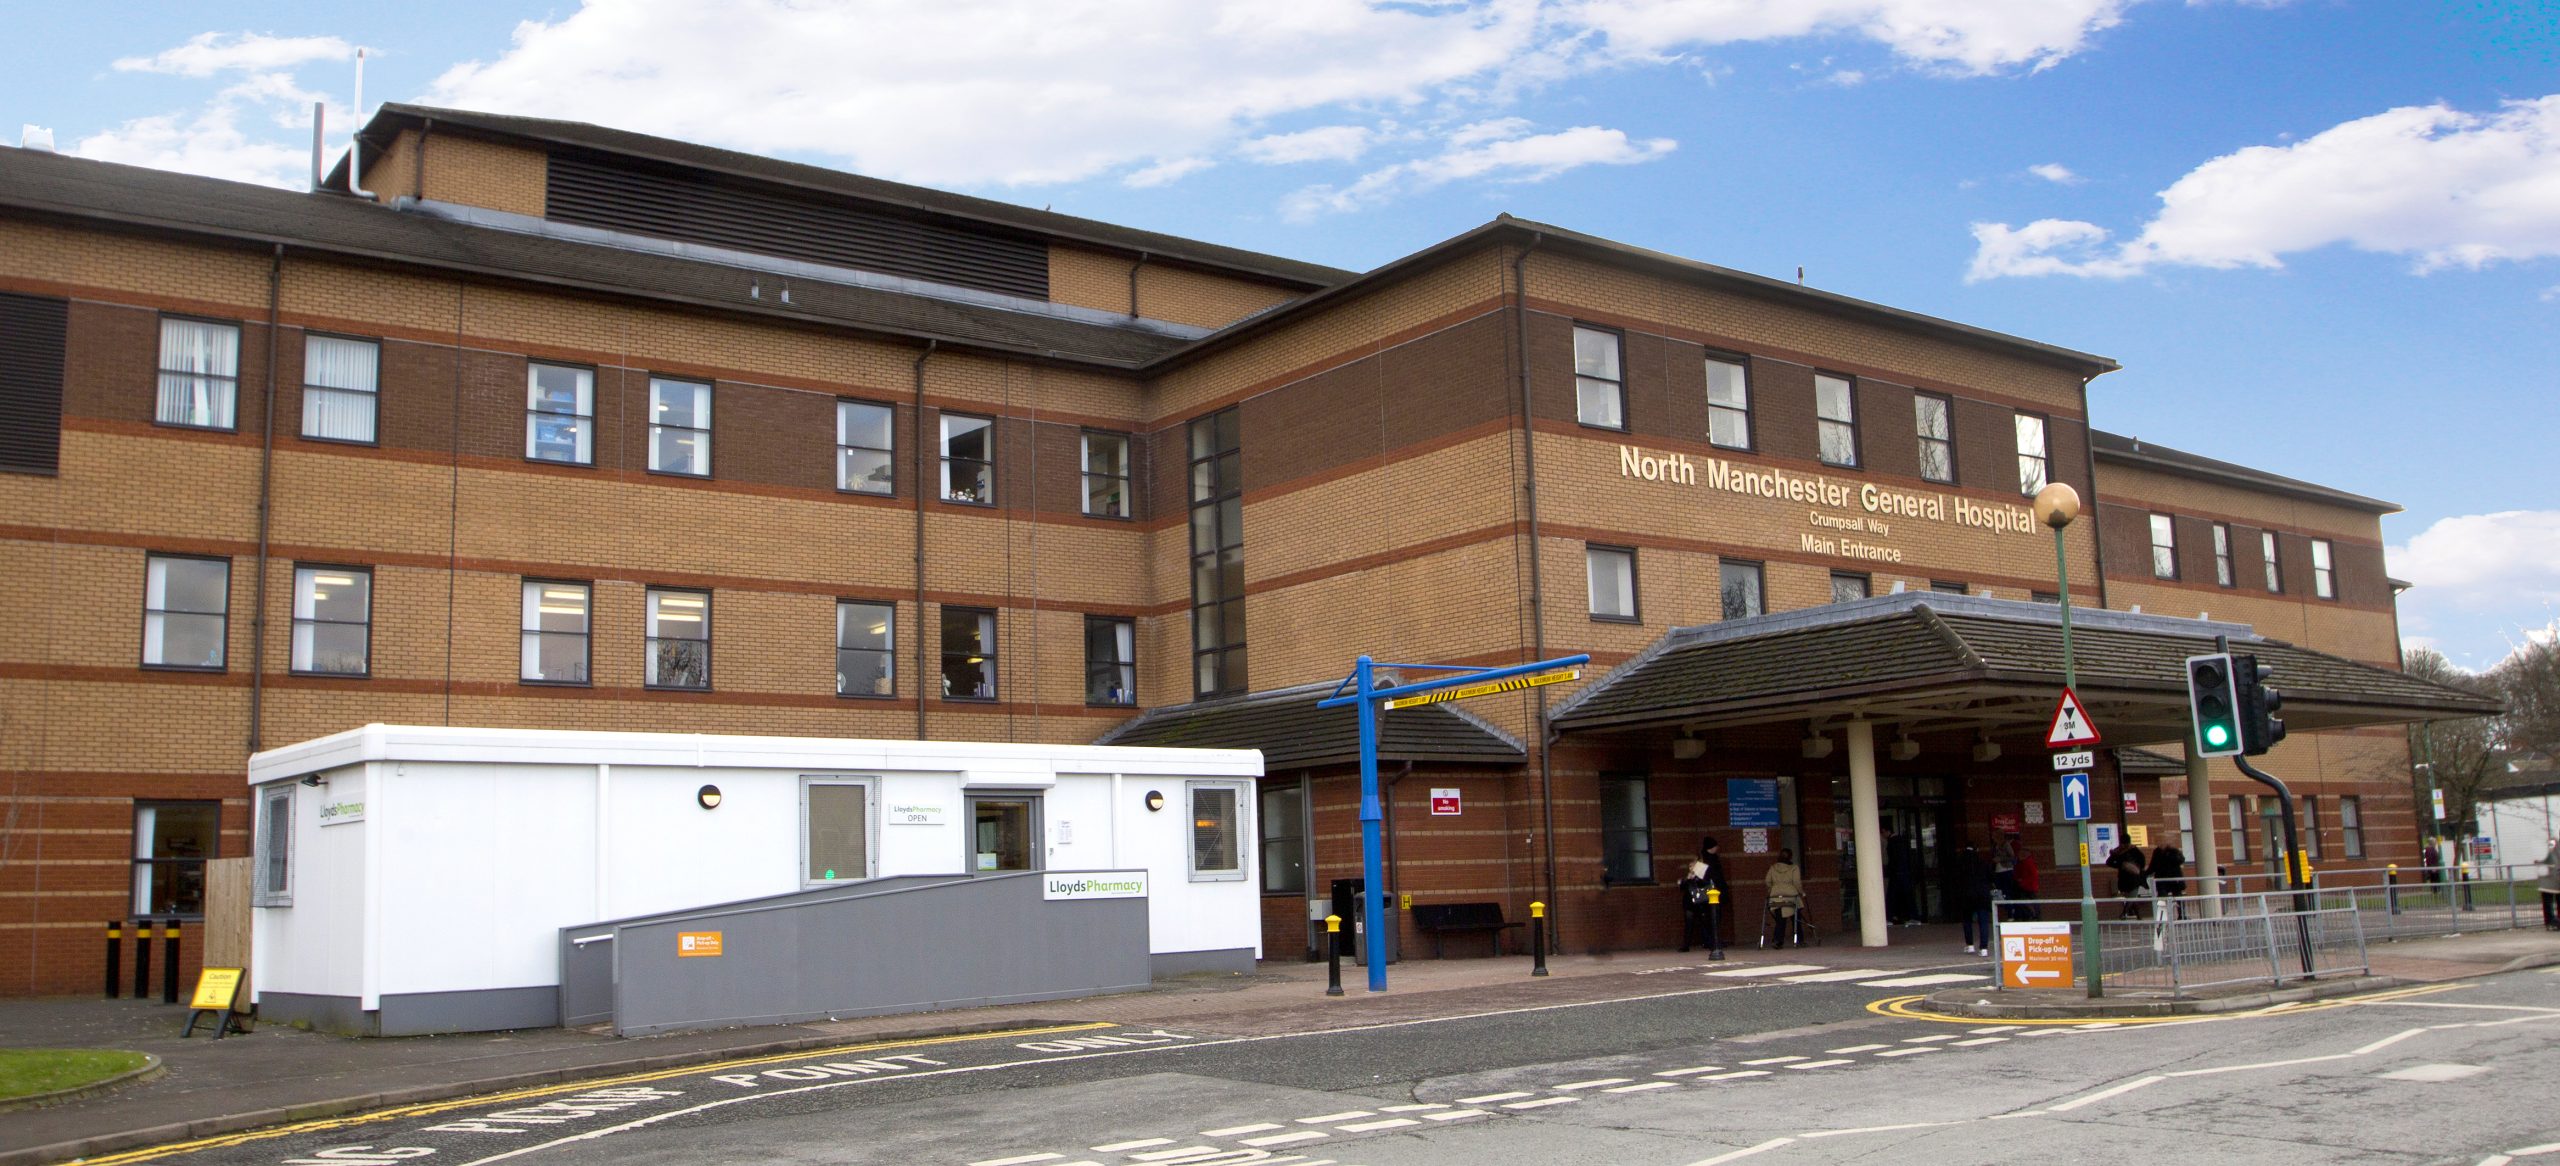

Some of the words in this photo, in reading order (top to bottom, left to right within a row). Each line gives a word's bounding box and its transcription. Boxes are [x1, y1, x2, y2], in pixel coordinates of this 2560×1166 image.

[1619, 445, 1695, 486] North
[1707, 458, 1850, 507] Manchester
[1861, 483, 1945, 521] General
[1954, 496, 2036, 534] Hospital
[1810, 511, 1864, 531] Crumpsall
[1867, 518, 1889, 537] Way
[1801, 533, 1835, 555] Main
[1841, 538, 1901, 563] Entrance
[2056, 756, 2068, 766] 12
[2071, 754, 2090, 767] yds
[320, 803, 365, 821] LloydsPharmacy
[894, 805, 942, 814] LloydsPharmacy
[907, 814, 928, 822] OPEN
[1050, 880, 1143, 895] LloydsPharmacy
[2028, 937, 2054, 945] Drop-off
[2028, 945, 2052, 954] Pick-up
[2053, 946, 2068, 955] Only
[421, 1086, 685, 1134] PICKUP
[710, 1053, 947, 1087] POINT
[1016, 1029, 1194, 1053] ONLY
